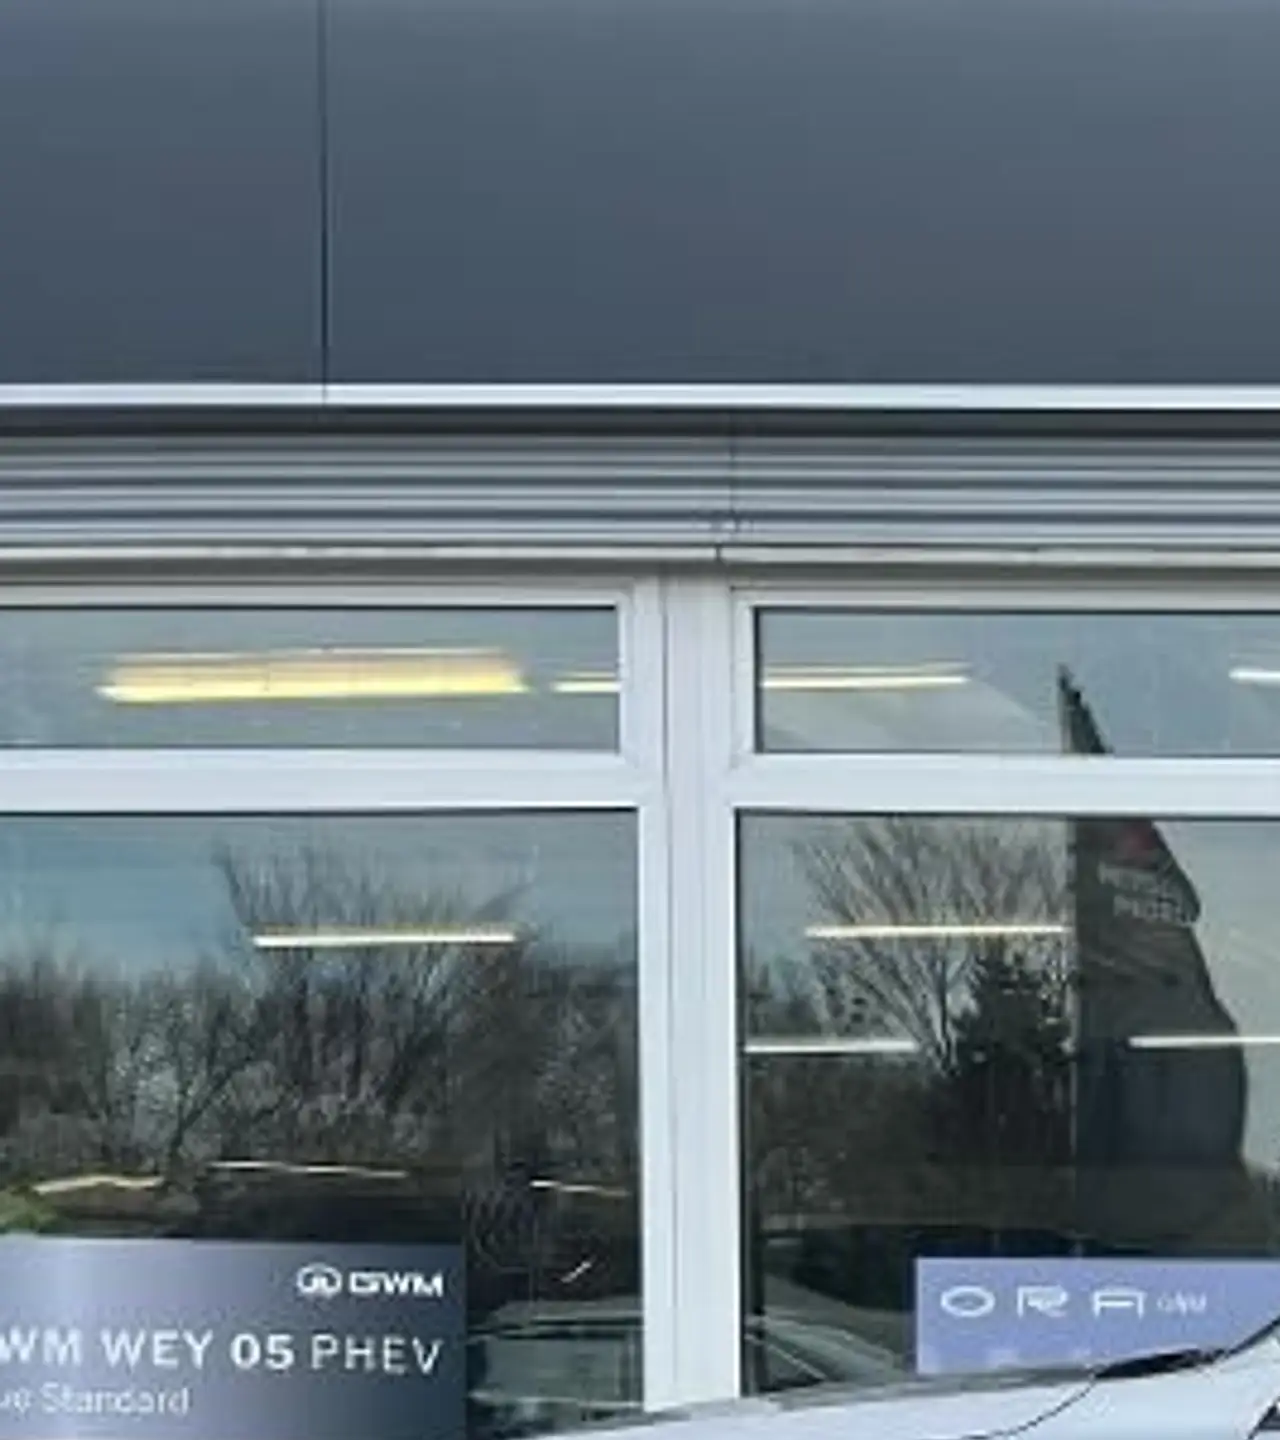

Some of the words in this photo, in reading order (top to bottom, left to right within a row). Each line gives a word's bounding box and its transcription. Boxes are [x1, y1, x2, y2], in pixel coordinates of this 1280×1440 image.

[348, 1271, 443, 1297] GWM
[101, 1328, 213, 1369] WEY
[230, 1333, 295, 1370] 05
[310, 1333, 443, 1375] PHEV
[40, 1381, 190, 1416] Standard
